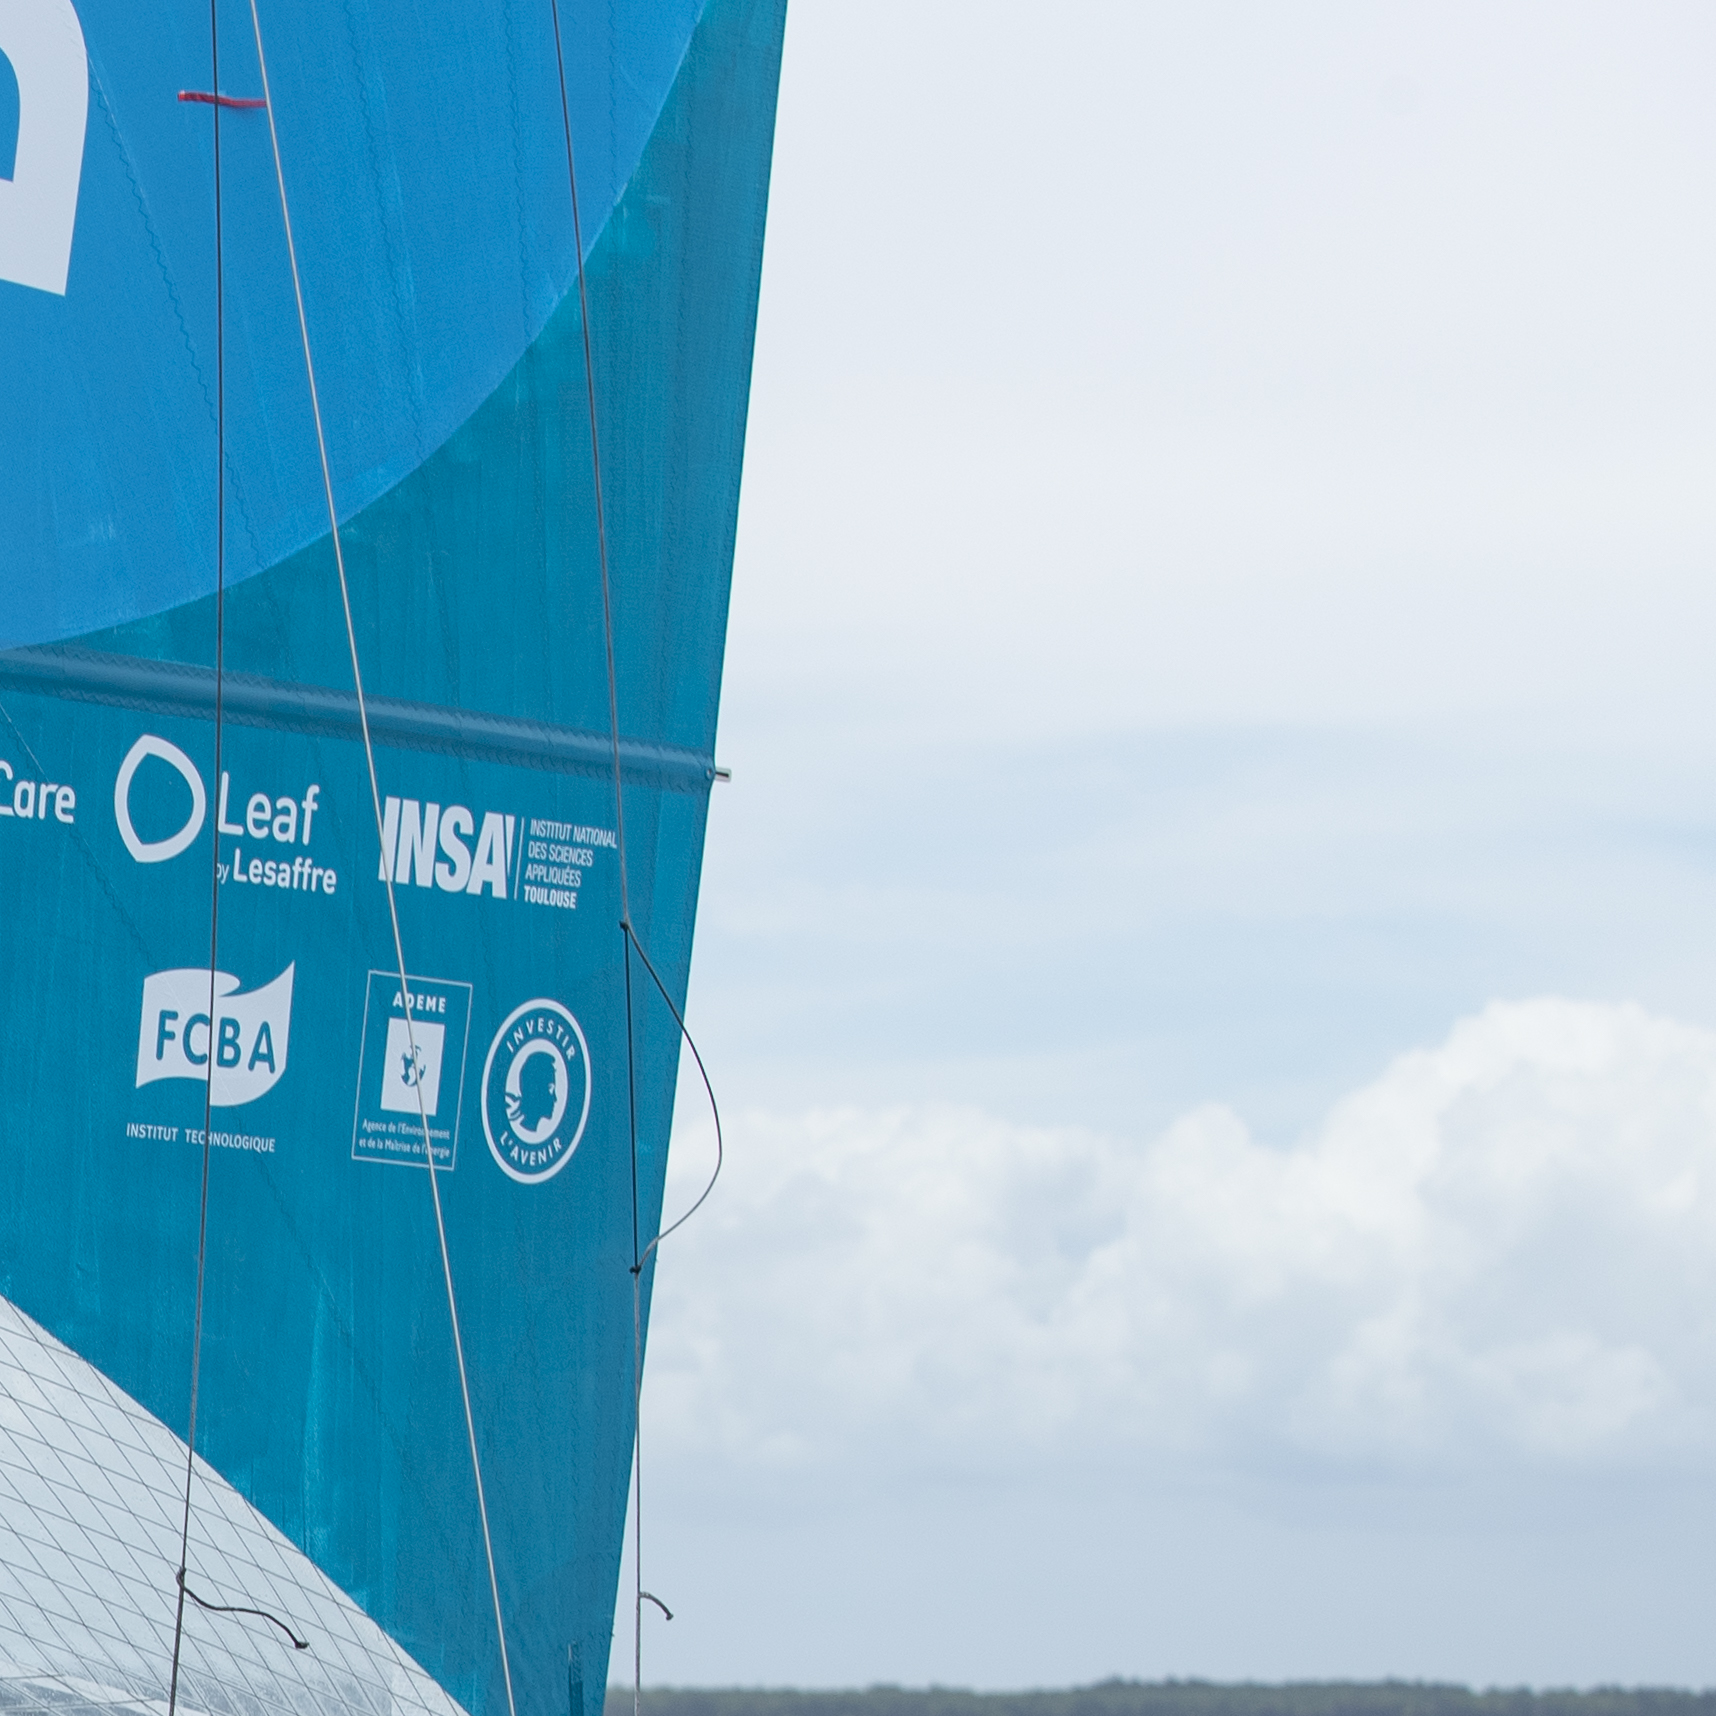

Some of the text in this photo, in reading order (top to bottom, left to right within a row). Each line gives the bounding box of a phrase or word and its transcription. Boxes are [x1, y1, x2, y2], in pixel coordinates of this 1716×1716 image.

[217, 770, 321, 847] Leaf
[377, 795, 516, 900] INSA
[529, 817, 618, 849] INSTITUT NATIONAL
[527, 840, 594, 868] DES SCIENCES
[232, 846, 338, 895] Lesaffre
[524, 863, 582, 888] APPLIQUÉES
[523, 884, 578, 909] TOULOUSE
[391, 990, 447, 1014] ADEME
[153, 1008, 277, 1075] FCBA
[506, 1016, 577, 1062] INVESTIR
[125, 1122, 179, 1142] INSTITUT
[388, 1121, 396, 1134] de
[499, 1130, 563, 1167] L'AVENIR
